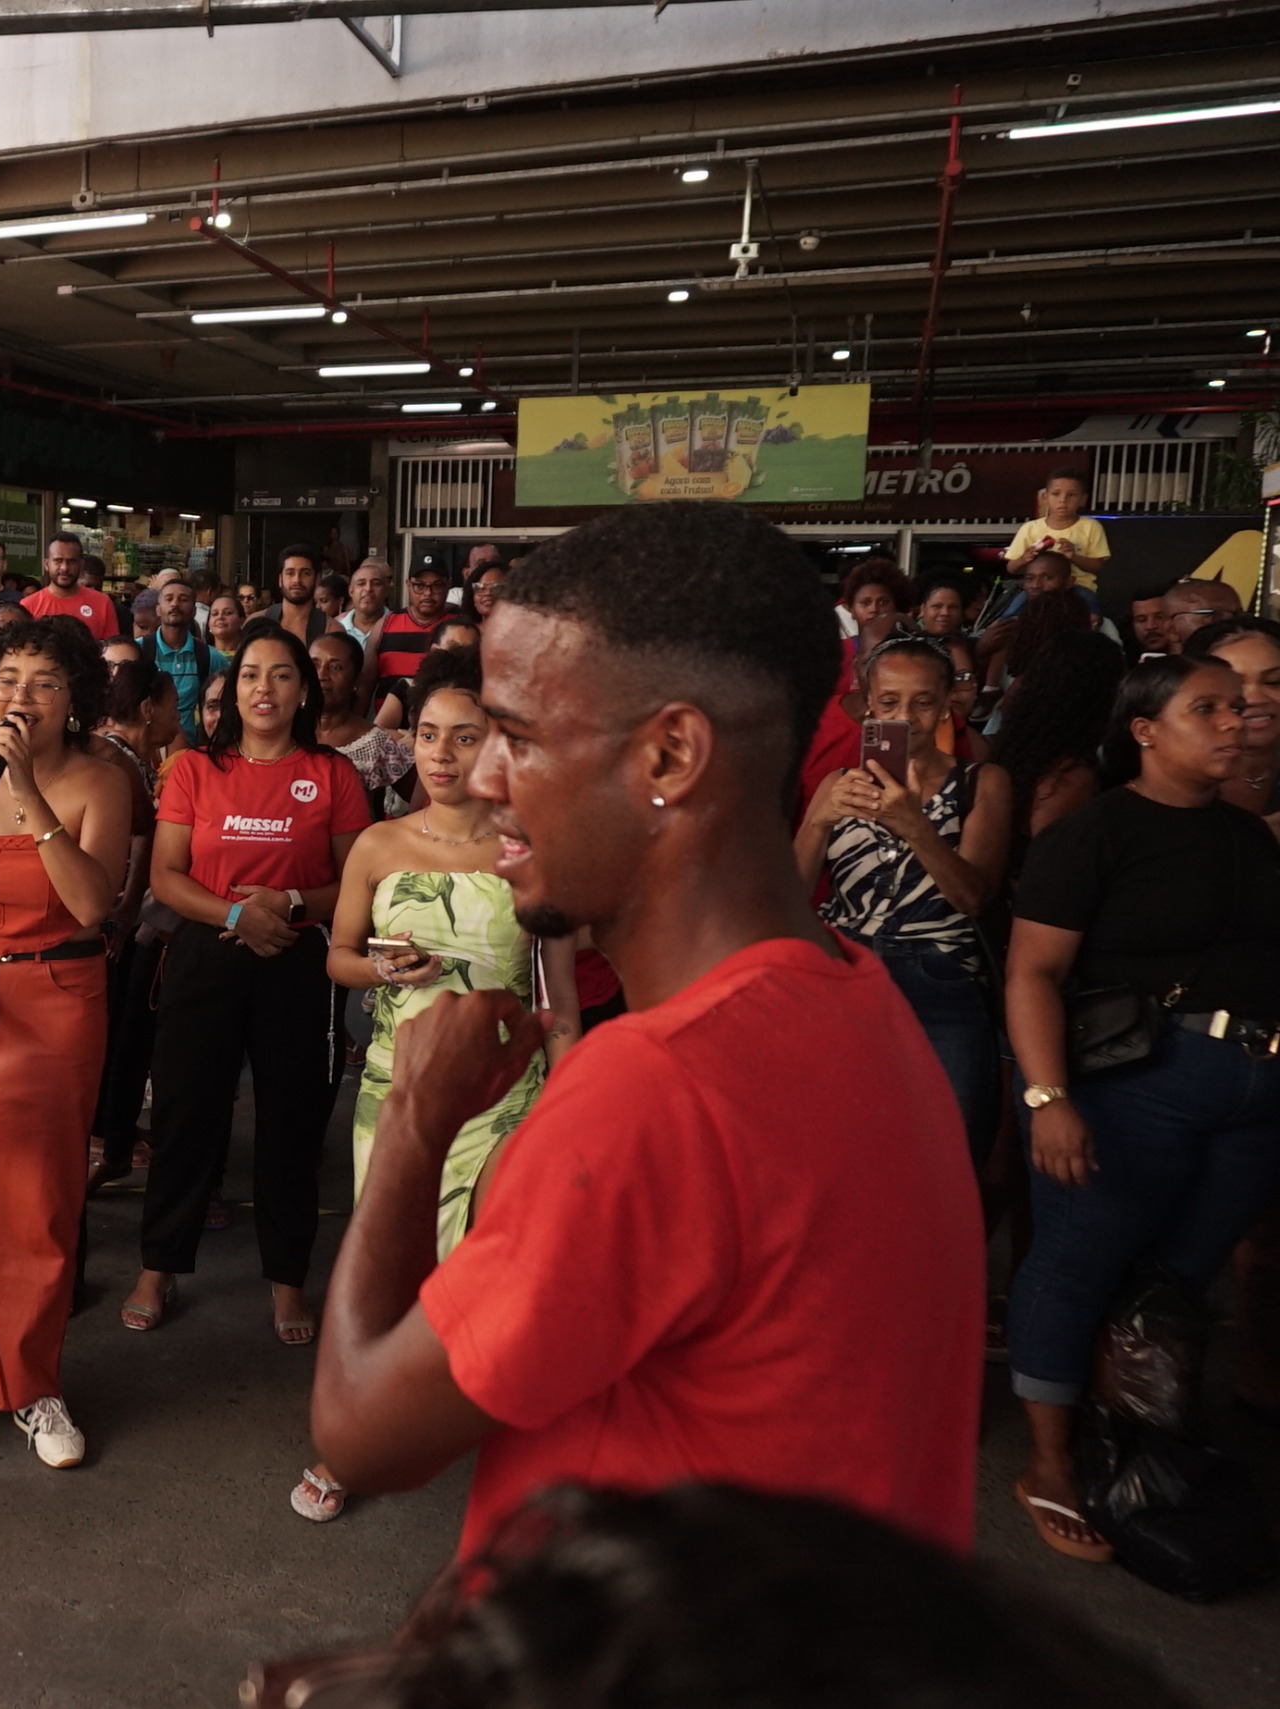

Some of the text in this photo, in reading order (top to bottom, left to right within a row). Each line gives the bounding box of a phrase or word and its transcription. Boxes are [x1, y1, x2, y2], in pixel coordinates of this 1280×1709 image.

[664, 477, 690, 486] Agora
[808, 502, 829, 511] CCR
[294, 784, 314, 797] M!
[222, 815, 293, 833] Massa!
